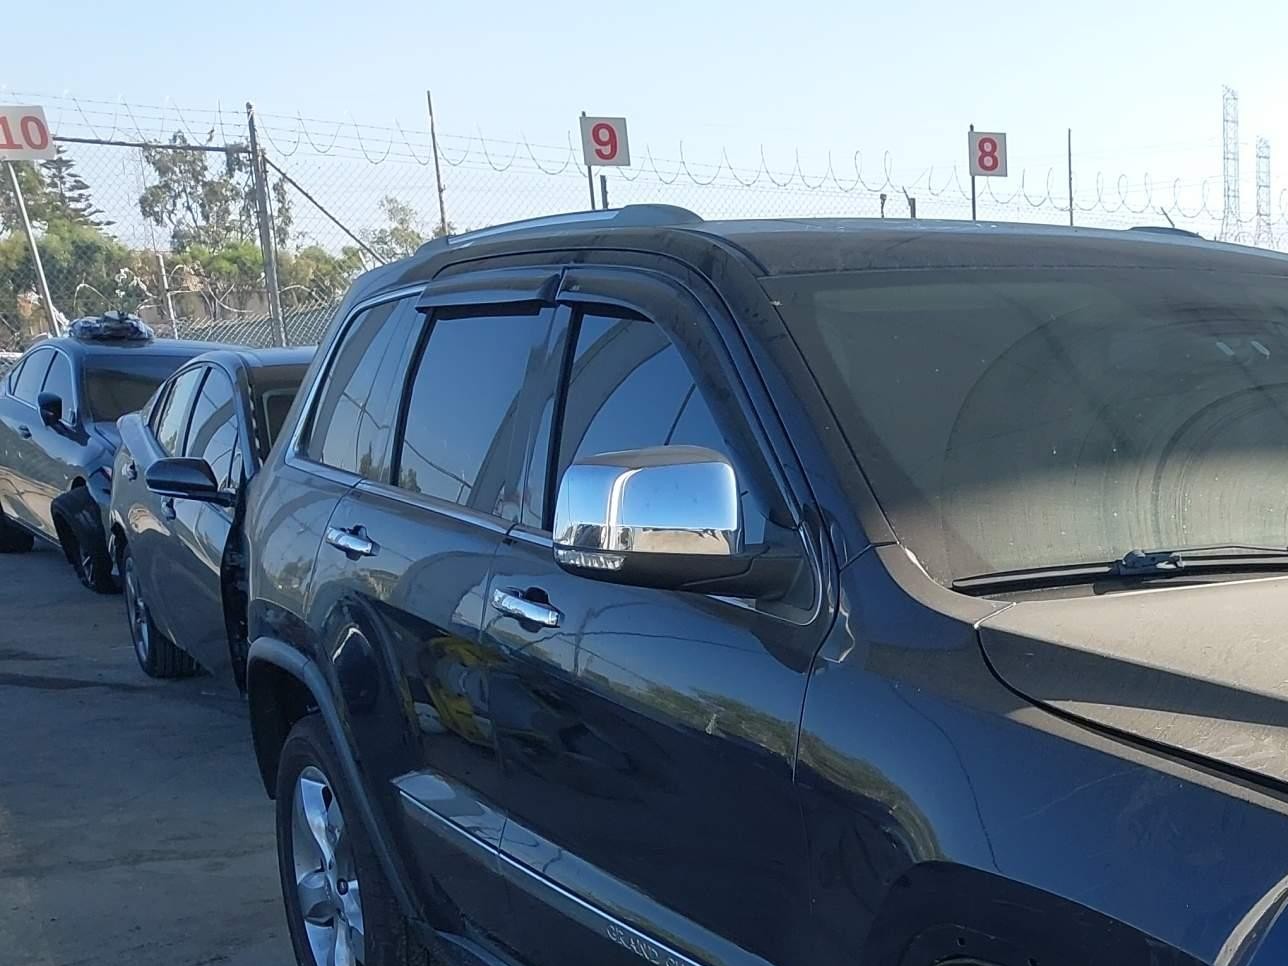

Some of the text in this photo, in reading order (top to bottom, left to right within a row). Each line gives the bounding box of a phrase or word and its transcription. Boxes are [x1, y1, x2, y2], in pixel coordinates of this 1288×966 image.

[0, 115, 49, 150] 10
[592, 123, 617, 160] 9
[978, 137, 998, 171] 8
[605, 924, 660, 965] GRAND
